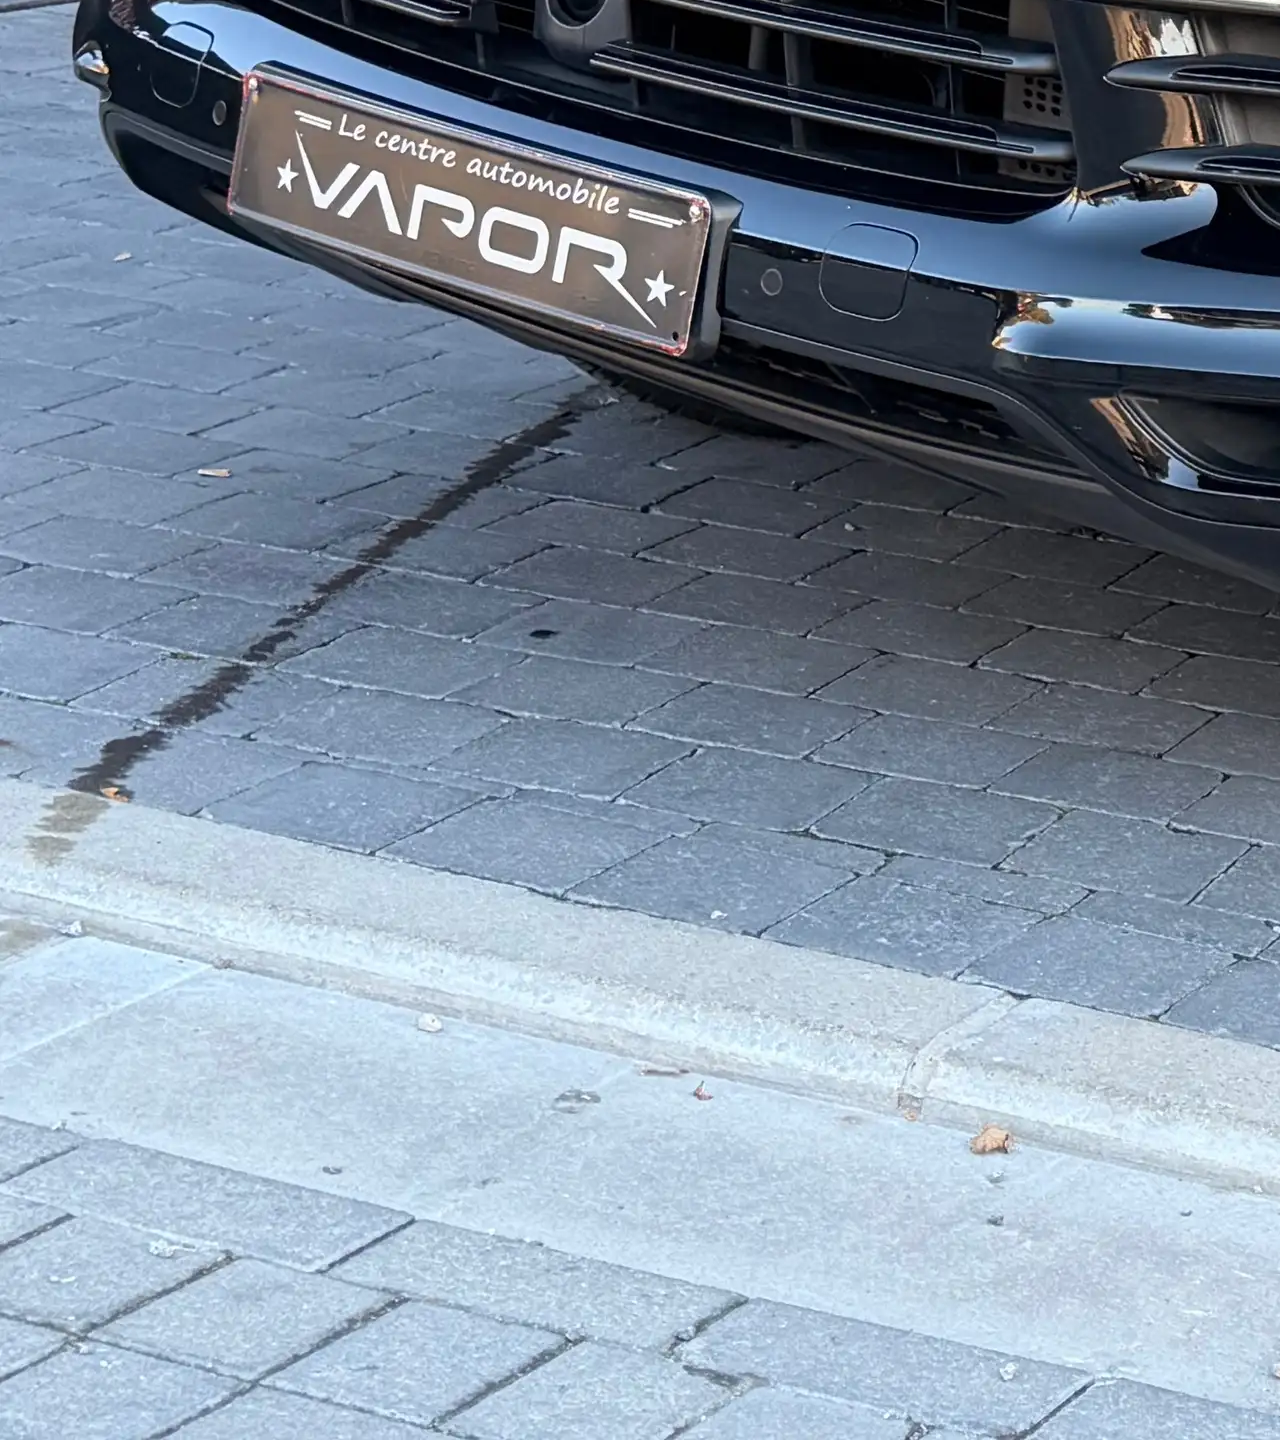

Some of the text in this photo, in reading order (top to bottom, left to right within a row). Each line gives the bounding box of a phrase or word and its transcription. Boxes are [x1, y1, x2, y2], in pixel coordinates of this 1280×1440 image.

[294, 129, 658, 329] VAPOR
[338, 113, 621, 214] Le centre automobile
